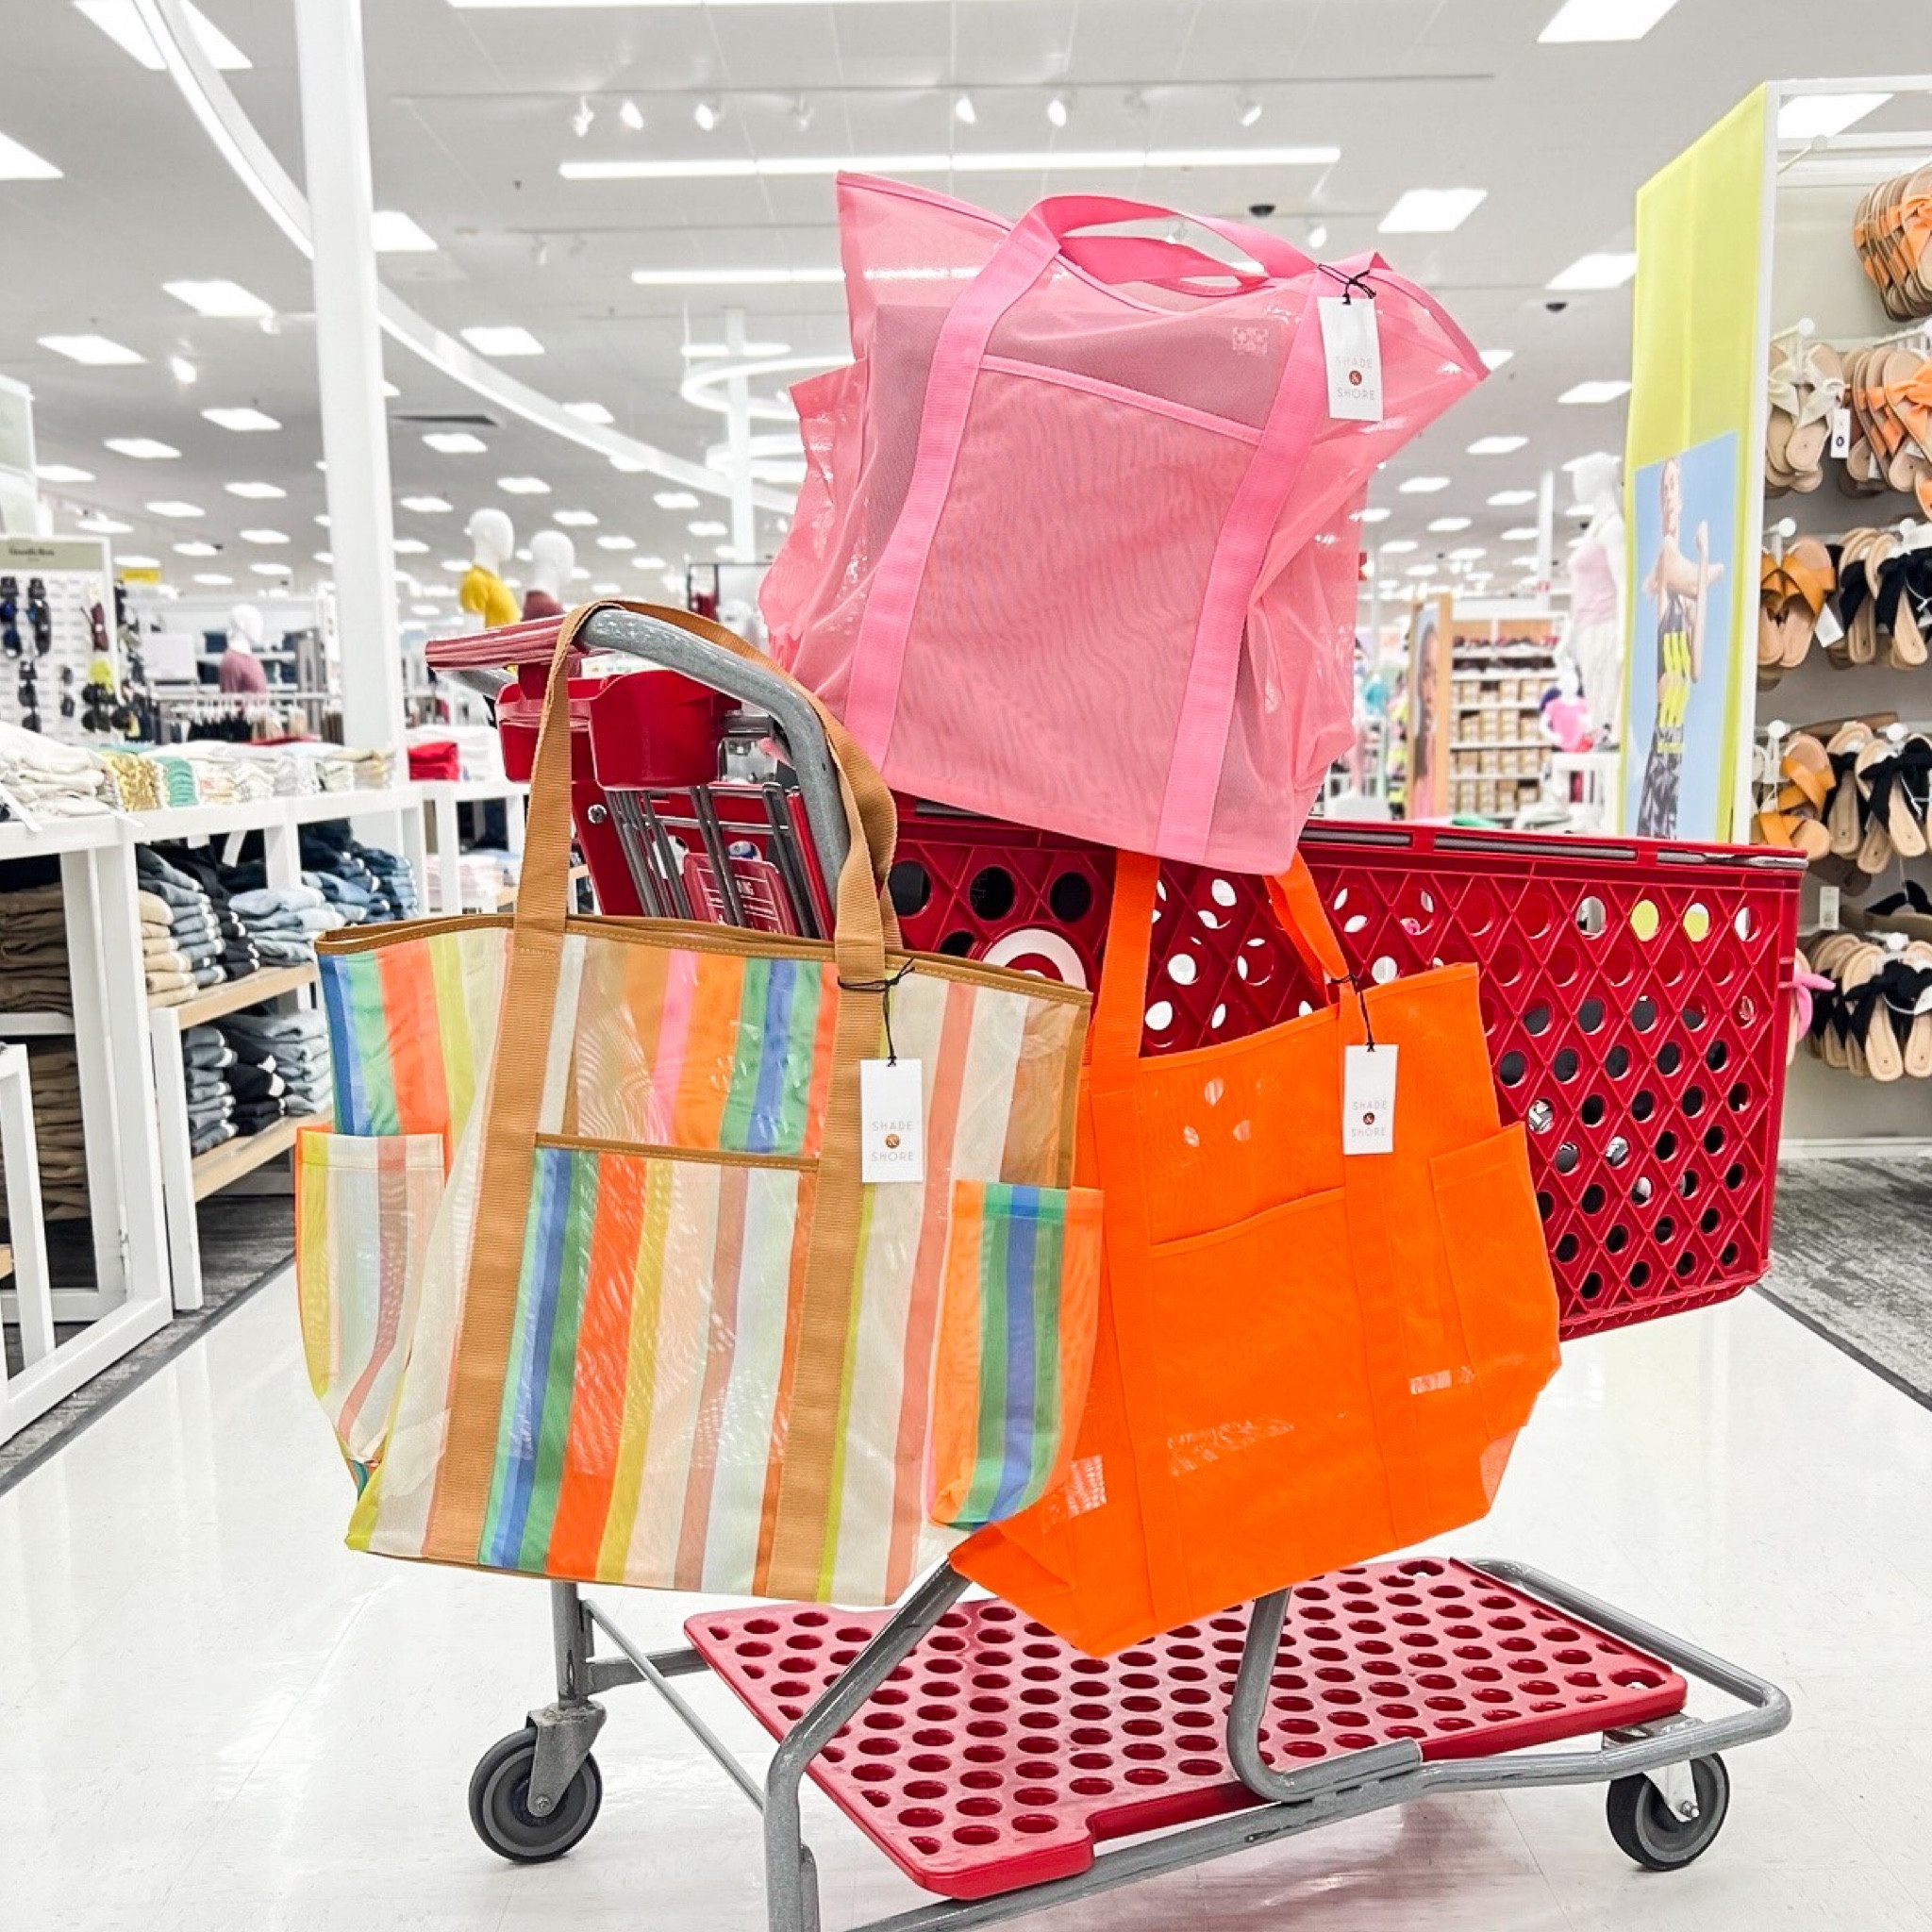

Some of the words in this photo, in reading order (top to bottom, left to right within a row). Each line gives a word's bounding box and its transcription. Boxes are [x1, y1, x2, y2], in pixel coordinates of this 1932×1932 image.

[1336, 355, 1374, 369] SHADE
[1349, 371, 1361, 385] &
[1337, 386, 1375, 401] SHORE
[1352, 1099, 1389, 1111] SHADE
[1363, 1112, 1374, 1124] &
[872, 1120, 914, 1132] SHADE
[1351, 1126, 1387, 1139] SHORE
[871, 1151, 914, 1162] SHORE
